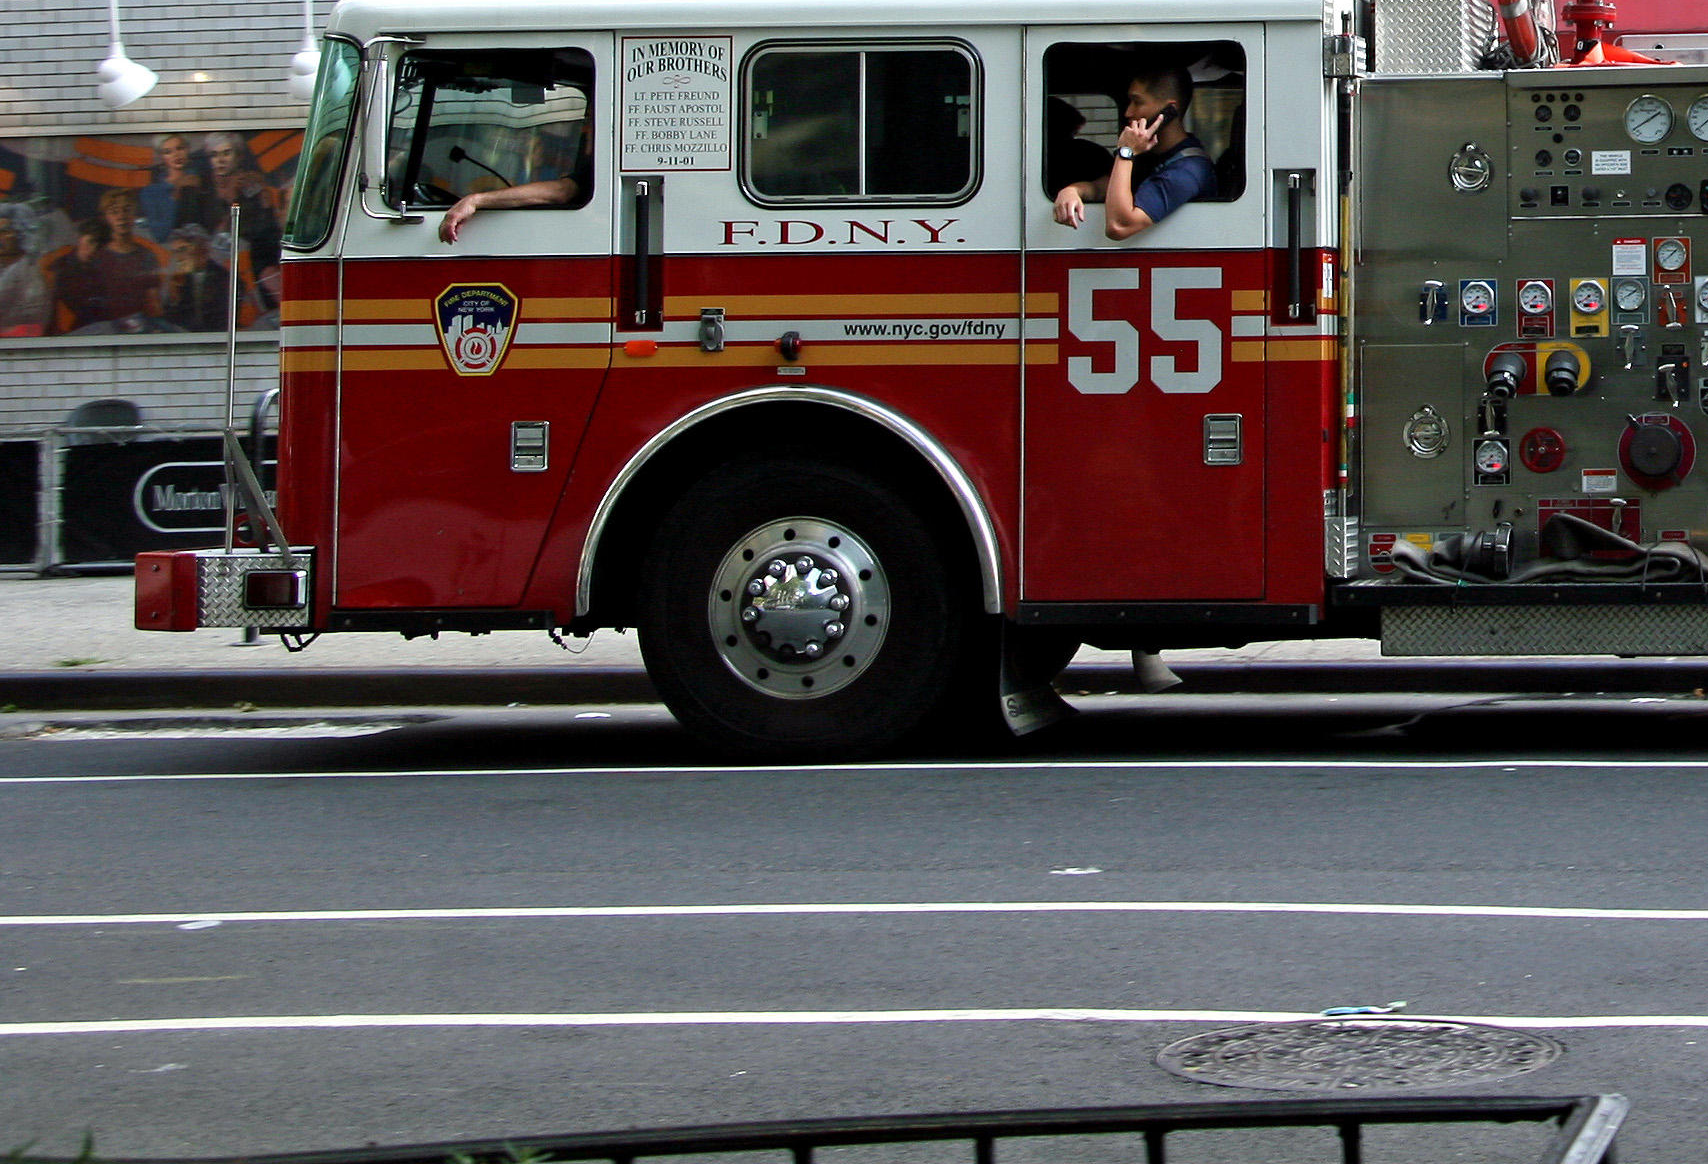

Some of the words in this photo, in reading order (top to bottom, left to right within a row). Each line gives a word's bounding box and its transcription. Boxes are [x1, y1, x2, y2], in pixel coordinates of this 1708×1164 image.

[632, 46, 645, 63] IN
[649, 41, 705, 58] MEMORY
[708, 45, 725, 61] OF
[627, 61, 654, 83] OUR
[658, 57, 727, 82] BROTHERS
[634, 92, 648, 101] LT.
[650, 92, 675, 101] PETE
[678, 91, 720, 101] FREUND
[644, 104, 676, 114] FAUST
[679, 104, 724, 114] APOSTOL
[644, 117, 676, 127] STEVE
[679, 117, 724, 127] RUSSELL
[651, 130, 687, 140] BOBBY
[690, 130, 717, 140] LANE
[641, 143, 671, 153] CHRIS
[674, 143, 728, 153] MOZZILLO
[657, 156, 695, 166] 9-11-01
[718, 219, 966, 246] F.D.N.Y.
[844, 320, 1006, 340] www.nyc.gov/fdny
[1068, 267, 1223, 395] 55
